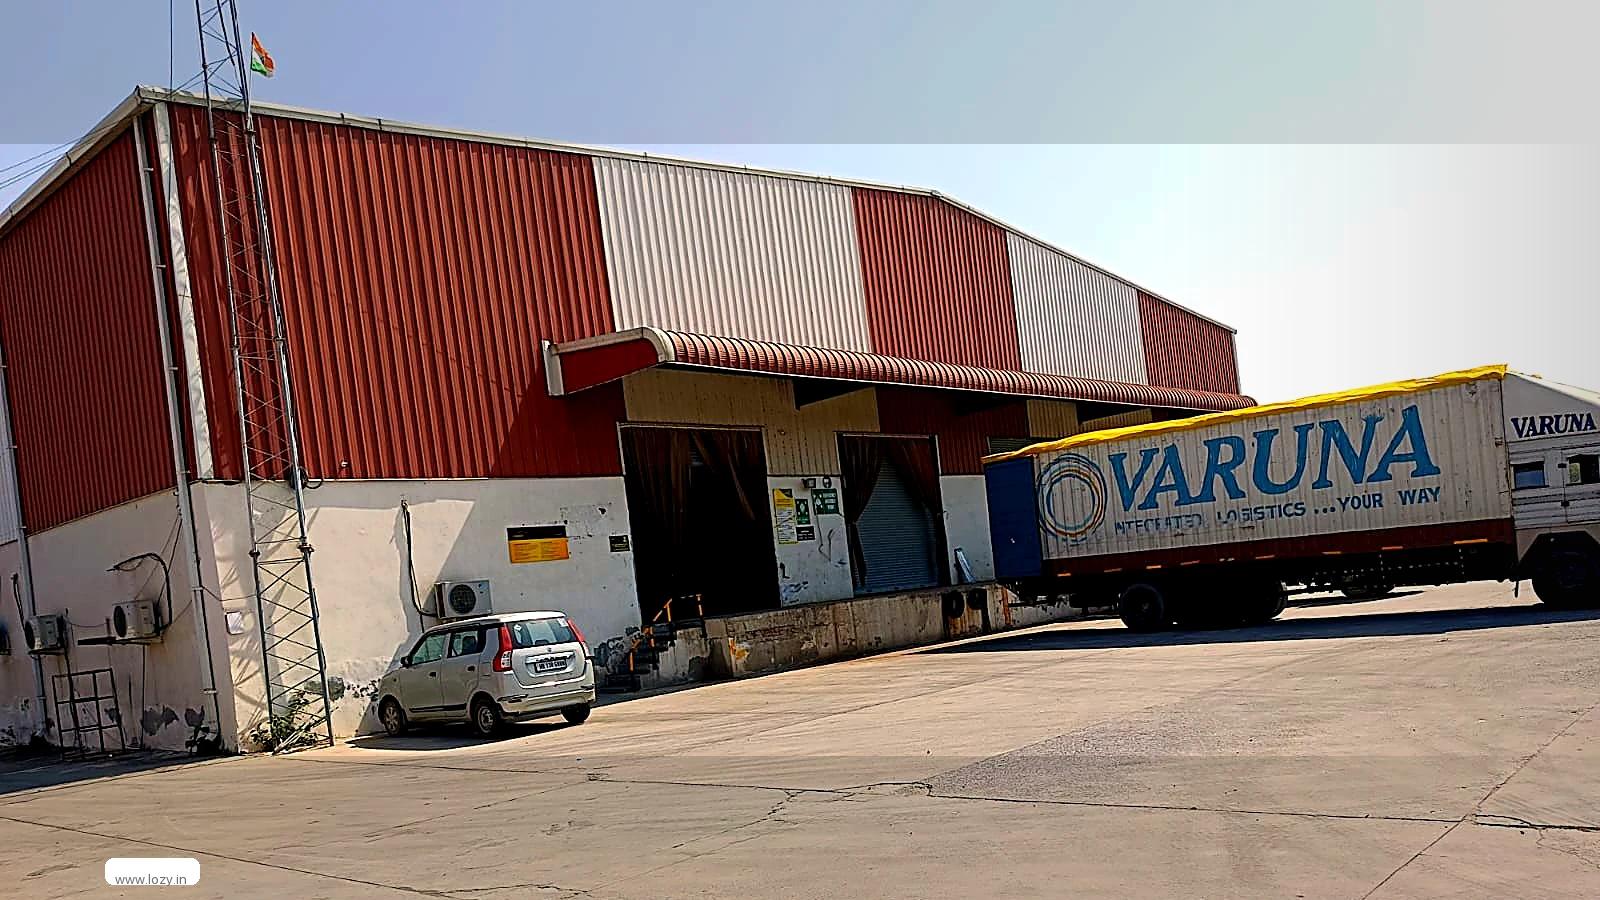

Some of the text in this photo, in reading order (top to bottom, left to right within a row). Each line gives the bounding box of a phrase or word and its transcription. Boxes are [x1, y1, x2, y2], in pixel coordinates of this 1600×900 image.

[1510, 412, 1597, 438] VARUNA
[1108, 404, 1441, 512] VARUNA
[1217, 502, 1306, 525] LOGISTICS
[1397, 486, 1441, 506] WAY
